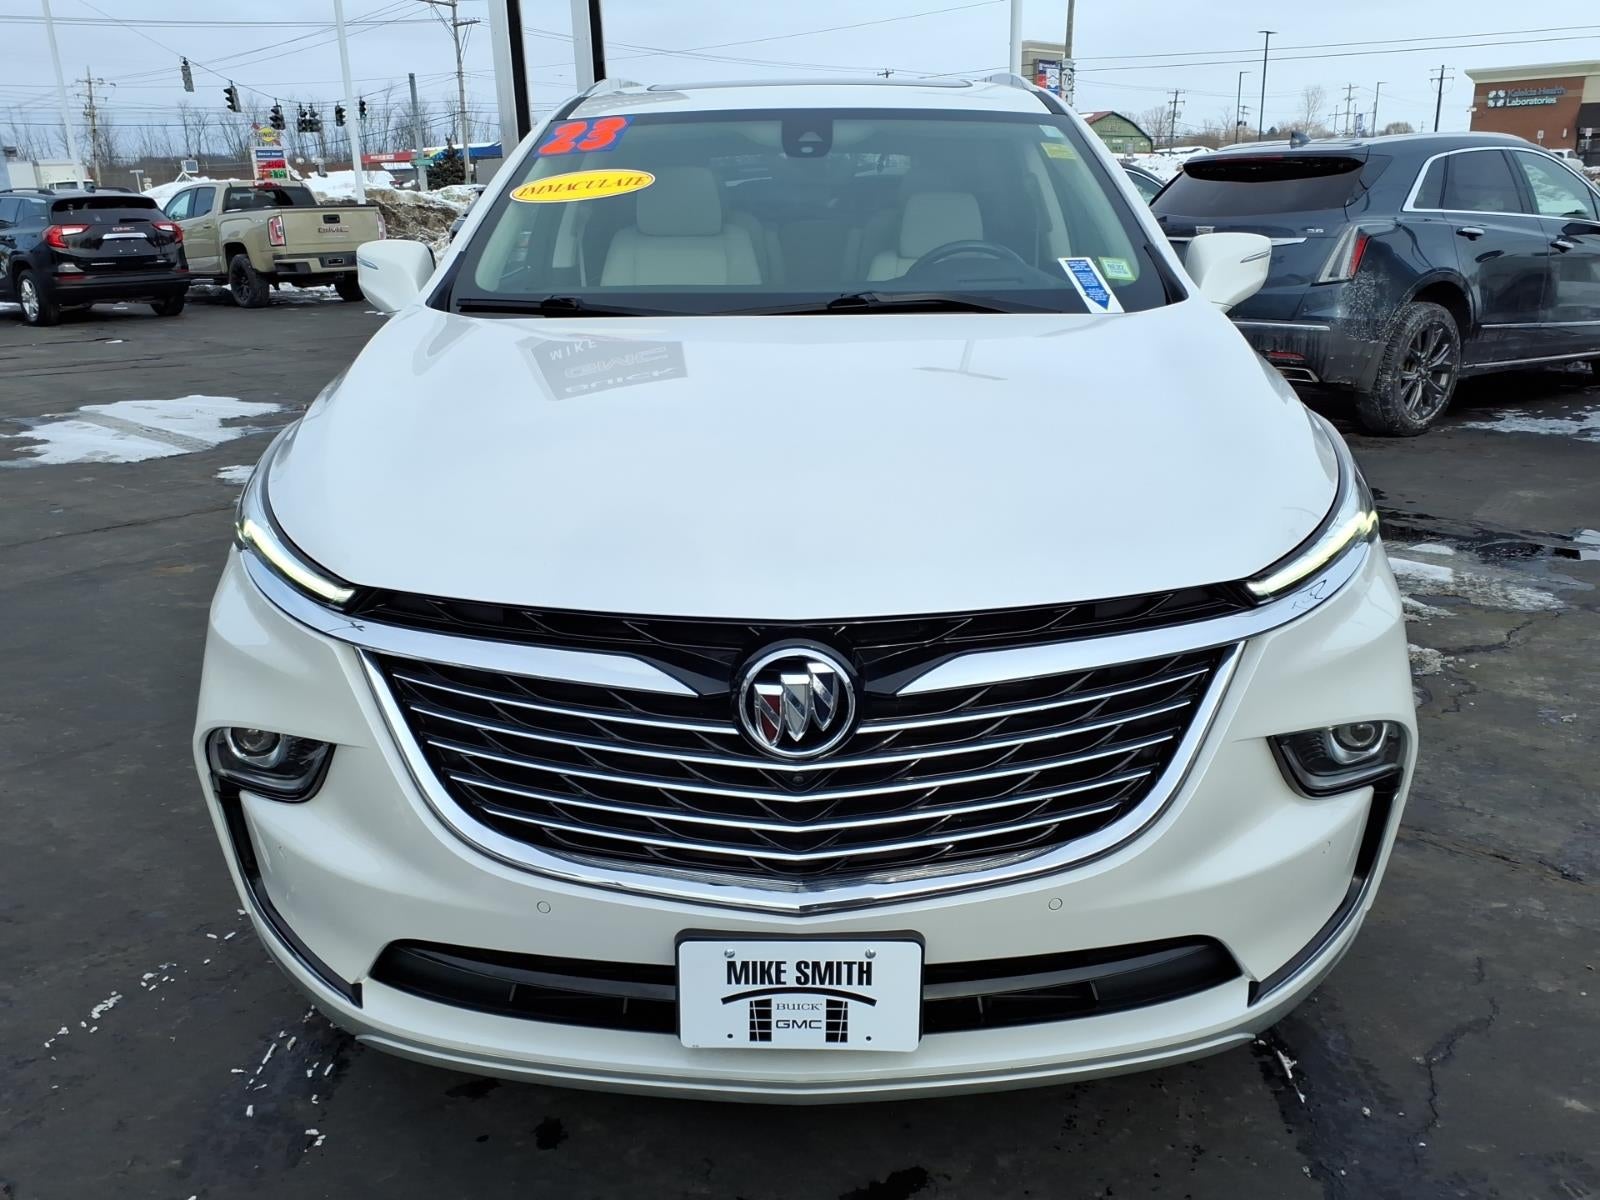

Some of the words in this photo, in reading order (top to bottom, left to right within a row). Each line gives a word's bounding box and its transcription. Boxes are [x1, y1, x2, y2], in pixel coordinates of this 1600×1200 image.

[1063, 73, 1073, 86] 78
[1506, 96, 1557, 107] Laboratories
[538, 116, 629, 155] 23
[518, 175, 650, 197] IMMACULATE
[727, 960, 787, 986] MIKE
[795, 960, 873, 986] SMITH
[775, 1003, 820, 1011] BUICK
[775, 1020, 822, 1030] GMC
